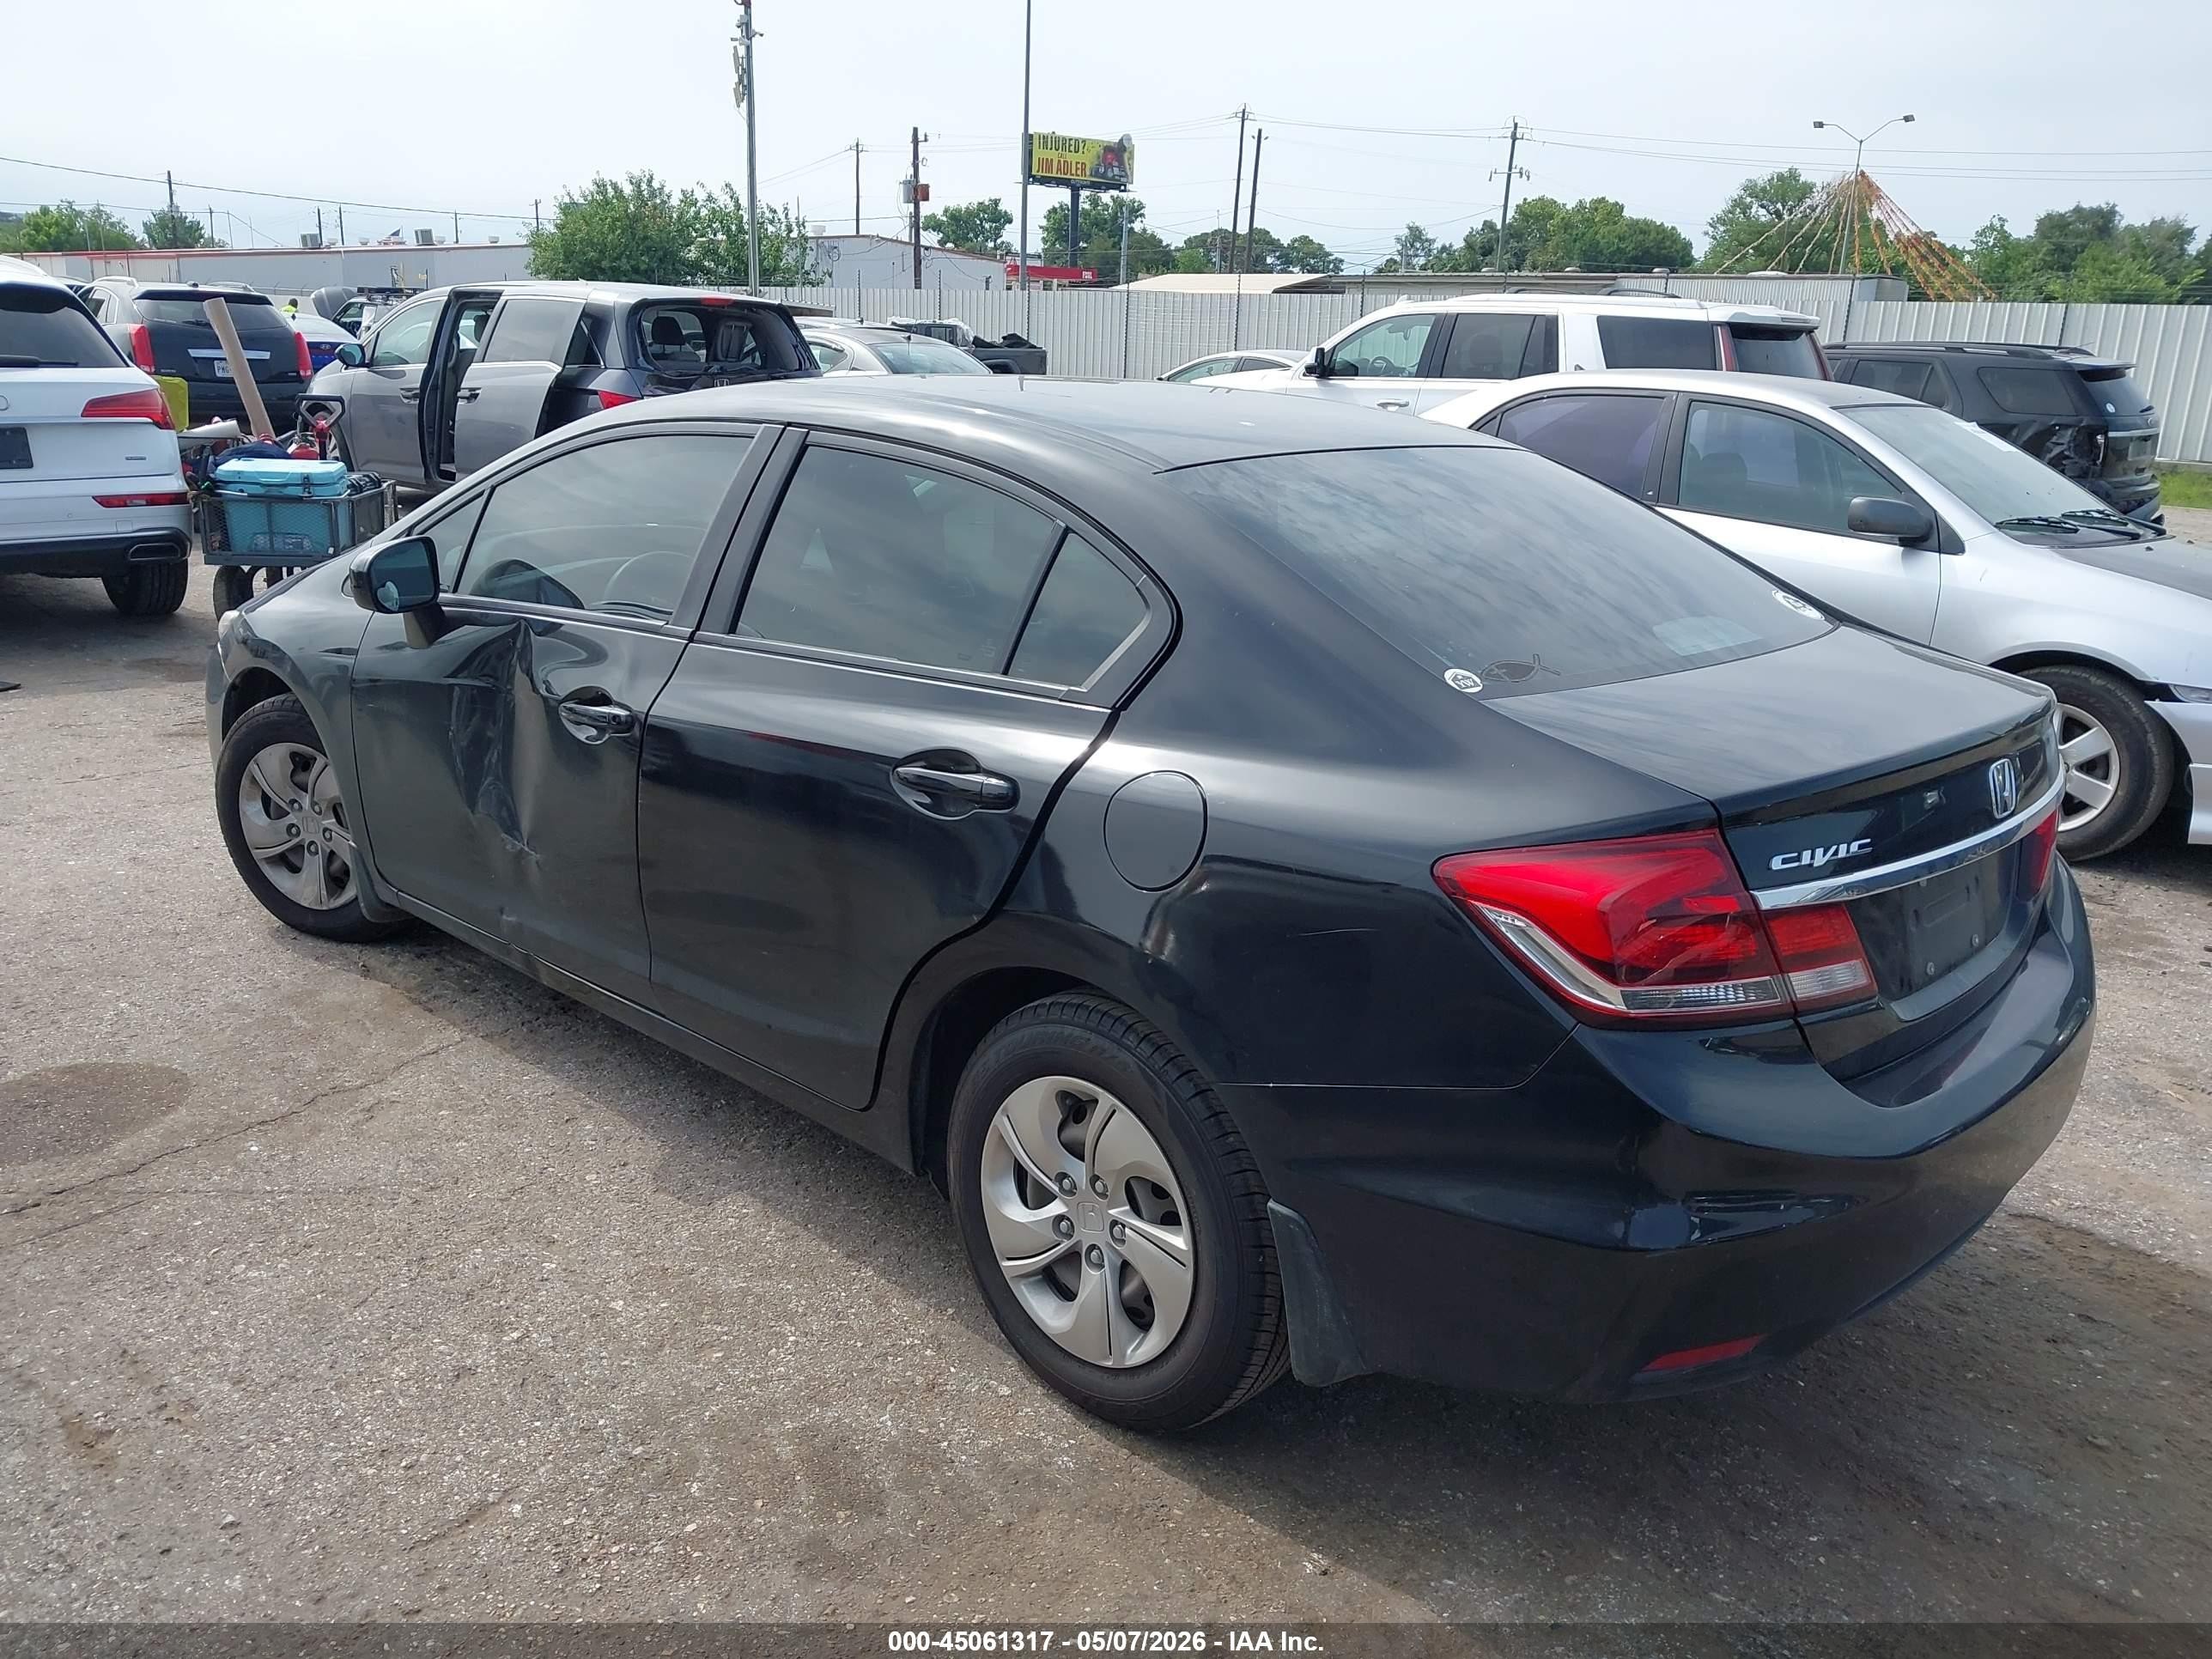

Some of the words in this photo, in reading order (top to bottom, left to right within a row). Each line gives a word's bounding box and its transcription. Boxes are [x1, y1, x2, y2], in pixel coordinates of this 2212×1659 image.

[1038, 134, 1086, 155] INJURED?
[1036, 157, 1054, 174] JIM
[1056, 159, 1087, 178] ADLER
[1770, 838, 1873, 870] CIVIC
